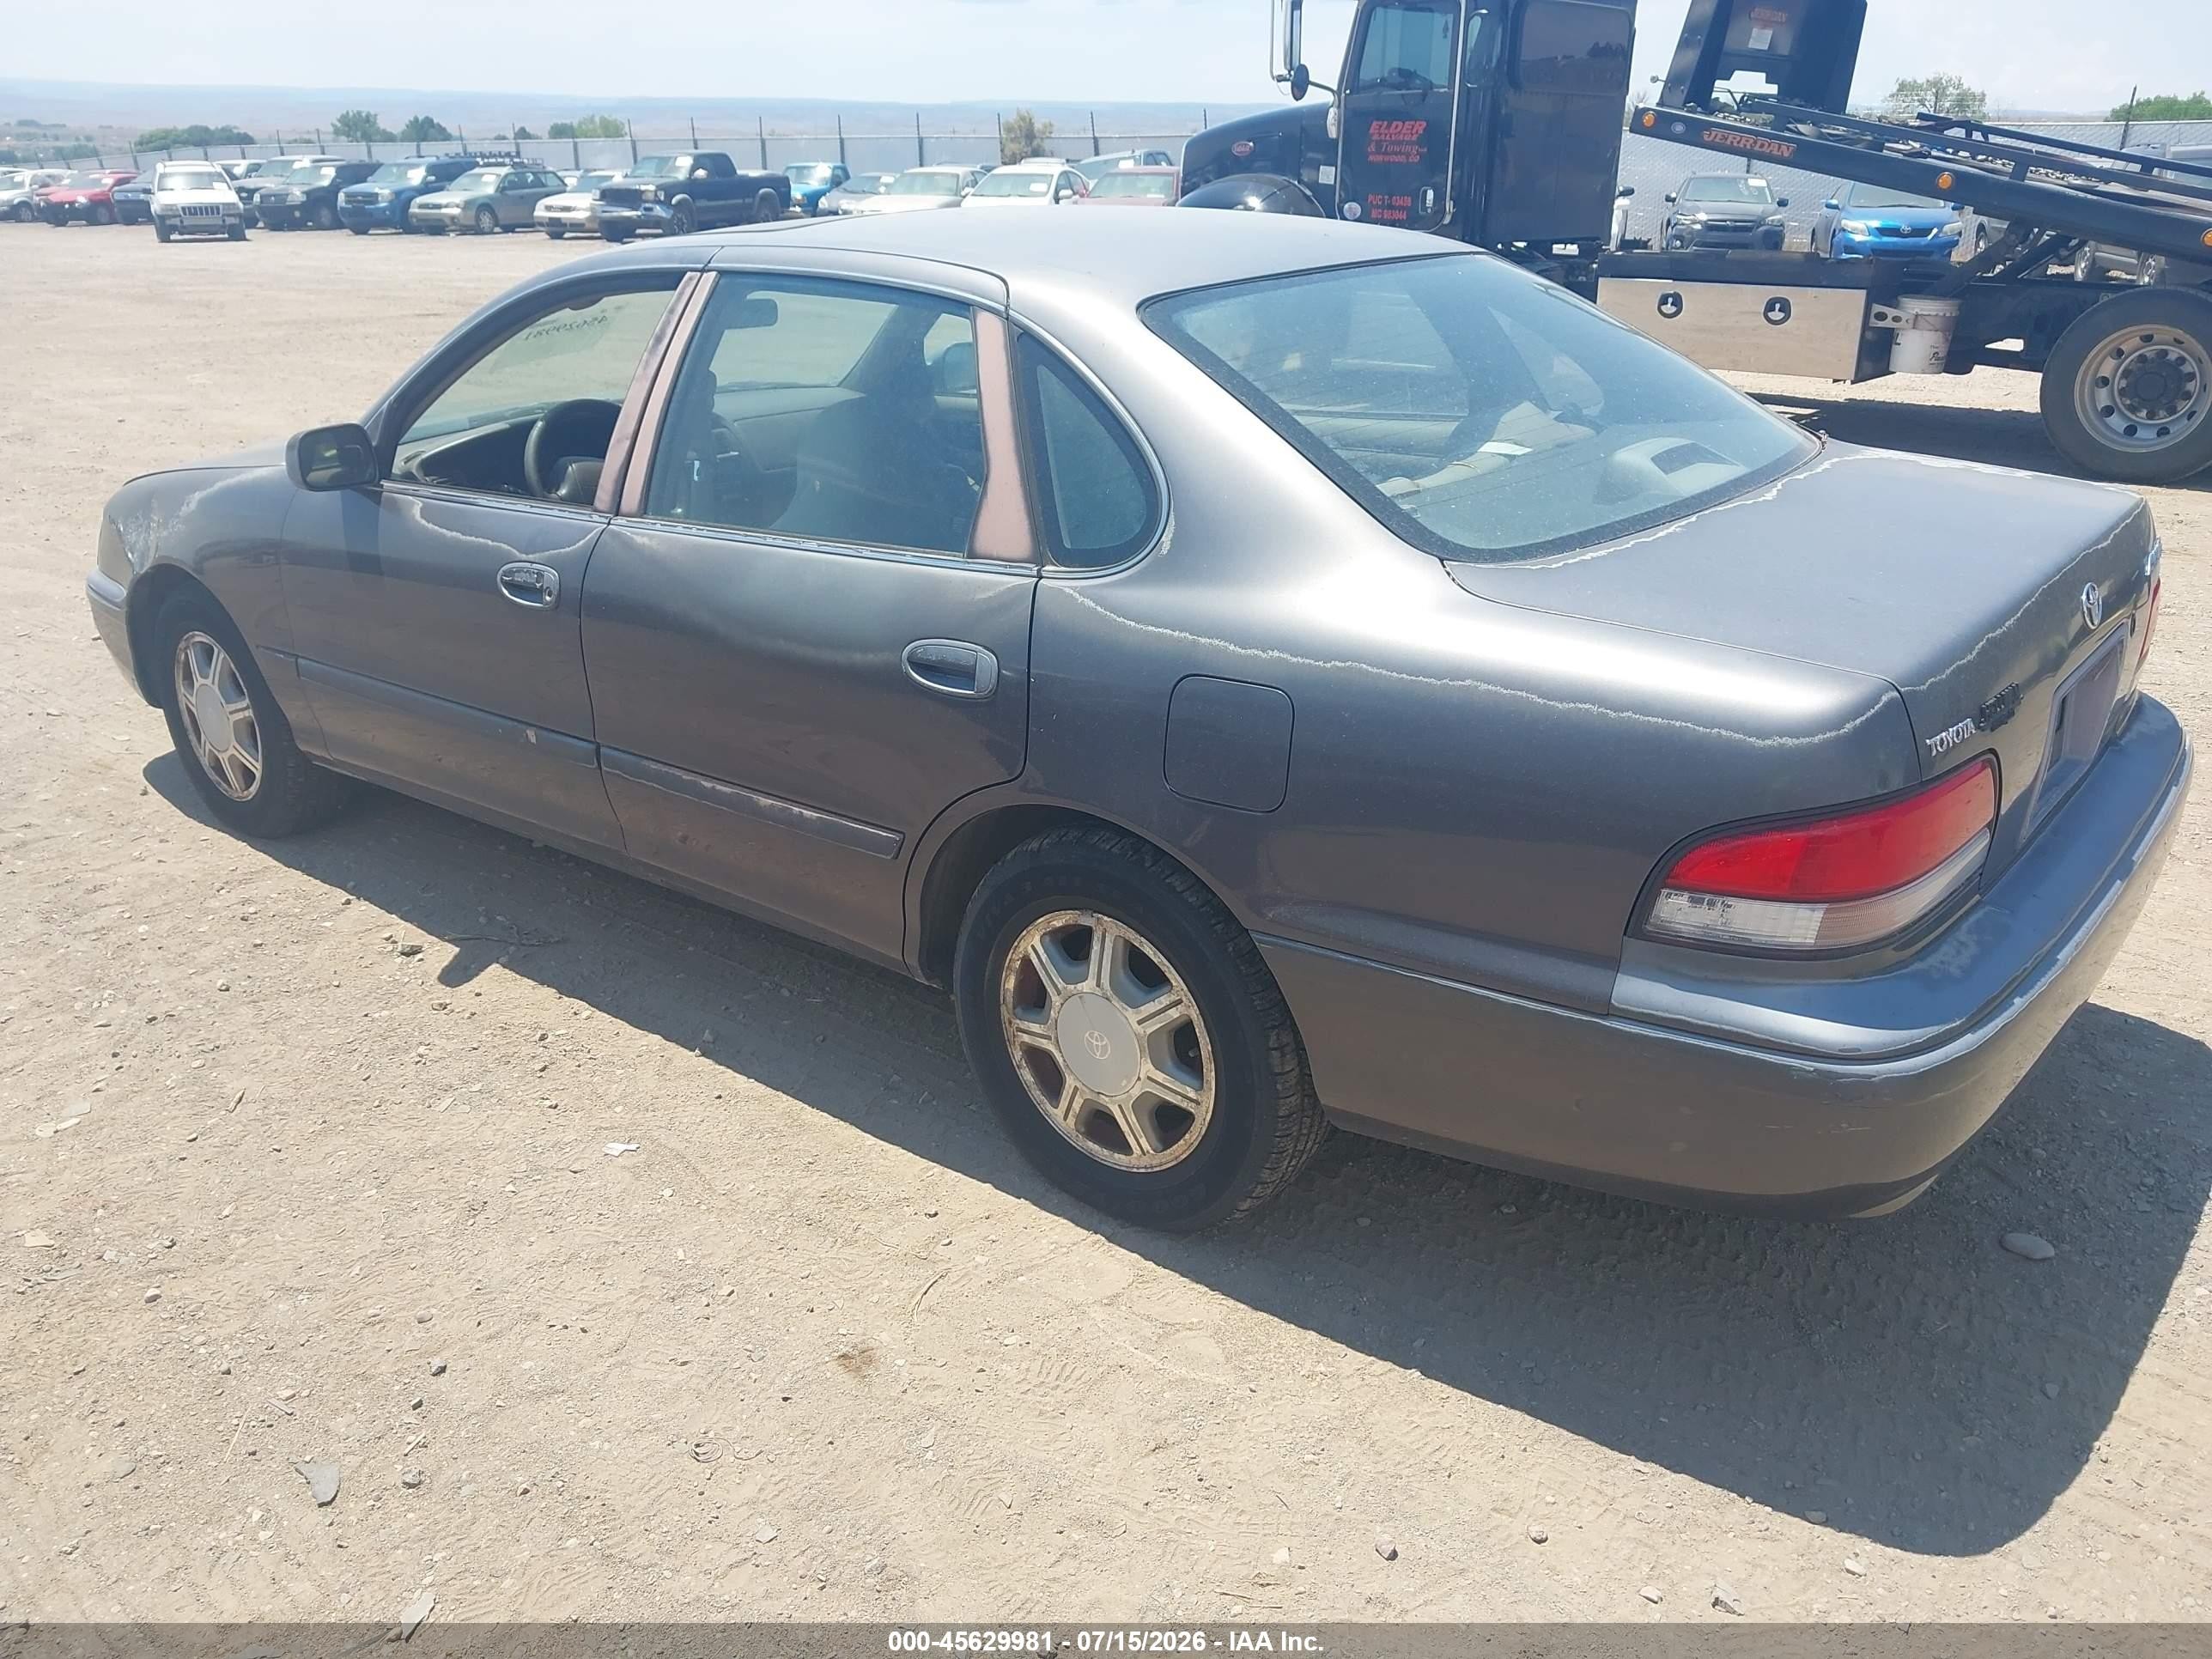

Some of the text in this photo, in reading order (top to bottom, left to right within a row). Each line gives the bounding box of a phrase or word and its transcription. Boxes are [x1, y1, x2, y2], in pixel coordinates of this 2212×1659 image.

[1369, 121, 1426, 134] ELDER
[1367, 142, 1376, 152] &
[1381, 141, 1418, 155] Towing
[1368, 194, 1382, 205] PUC
[1370, 209, 1382, 219] MC
[1926, 718, 1976, 757] TOYOTA
